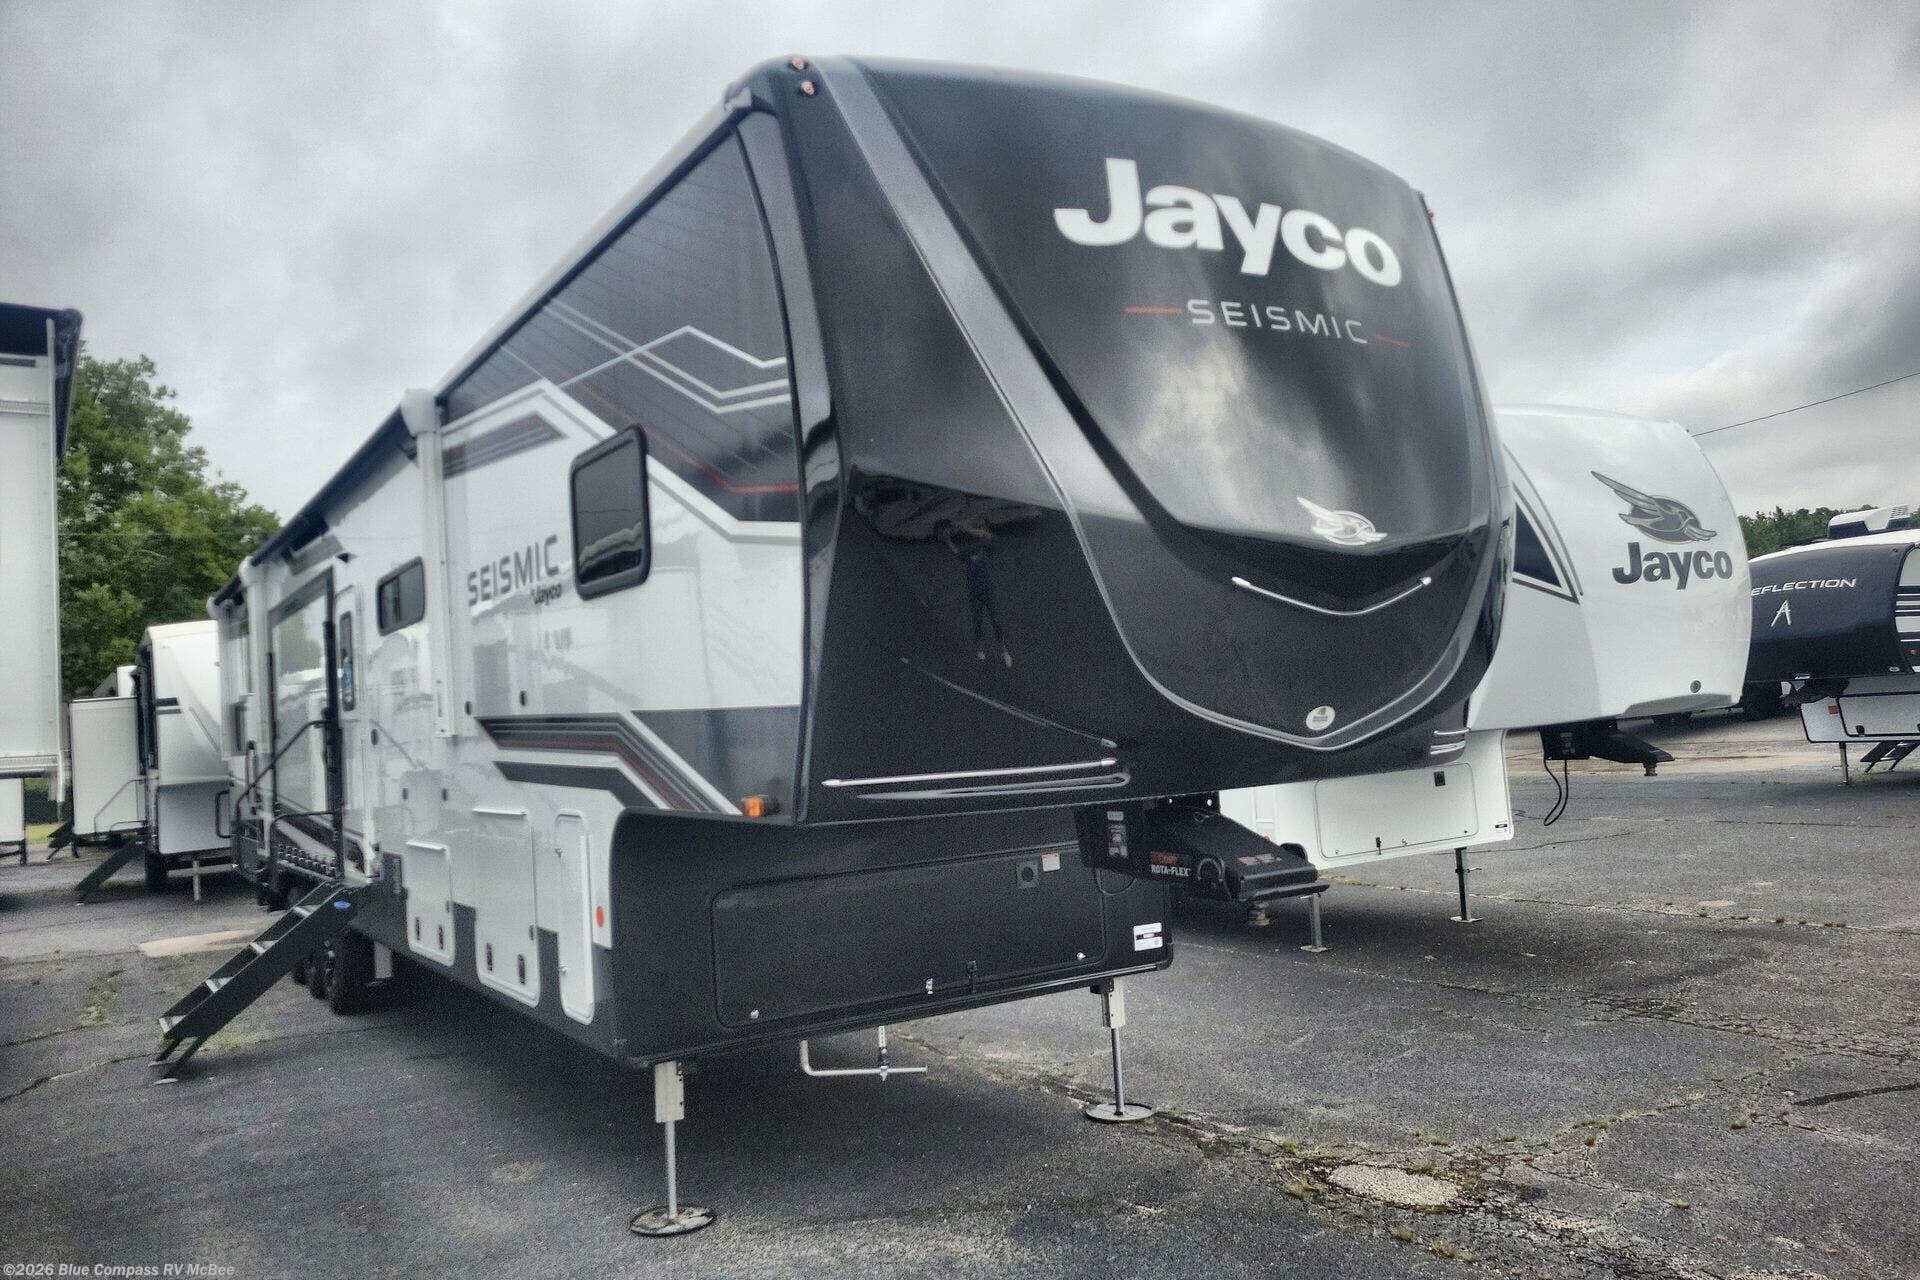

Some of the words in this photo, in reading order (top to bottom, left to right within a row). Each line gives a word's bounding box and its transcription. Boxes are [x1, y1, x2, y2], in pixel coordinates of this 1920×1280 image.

[1054, 157, 1402, 288] Jayco
[1186, 299, 1369, 345] SEISMIC
[467, 534, 560, 606] SEISMIC
[1612, 541, 1732, 590] Jayco
[1751, 578, 1857, 596] EFLECTION
